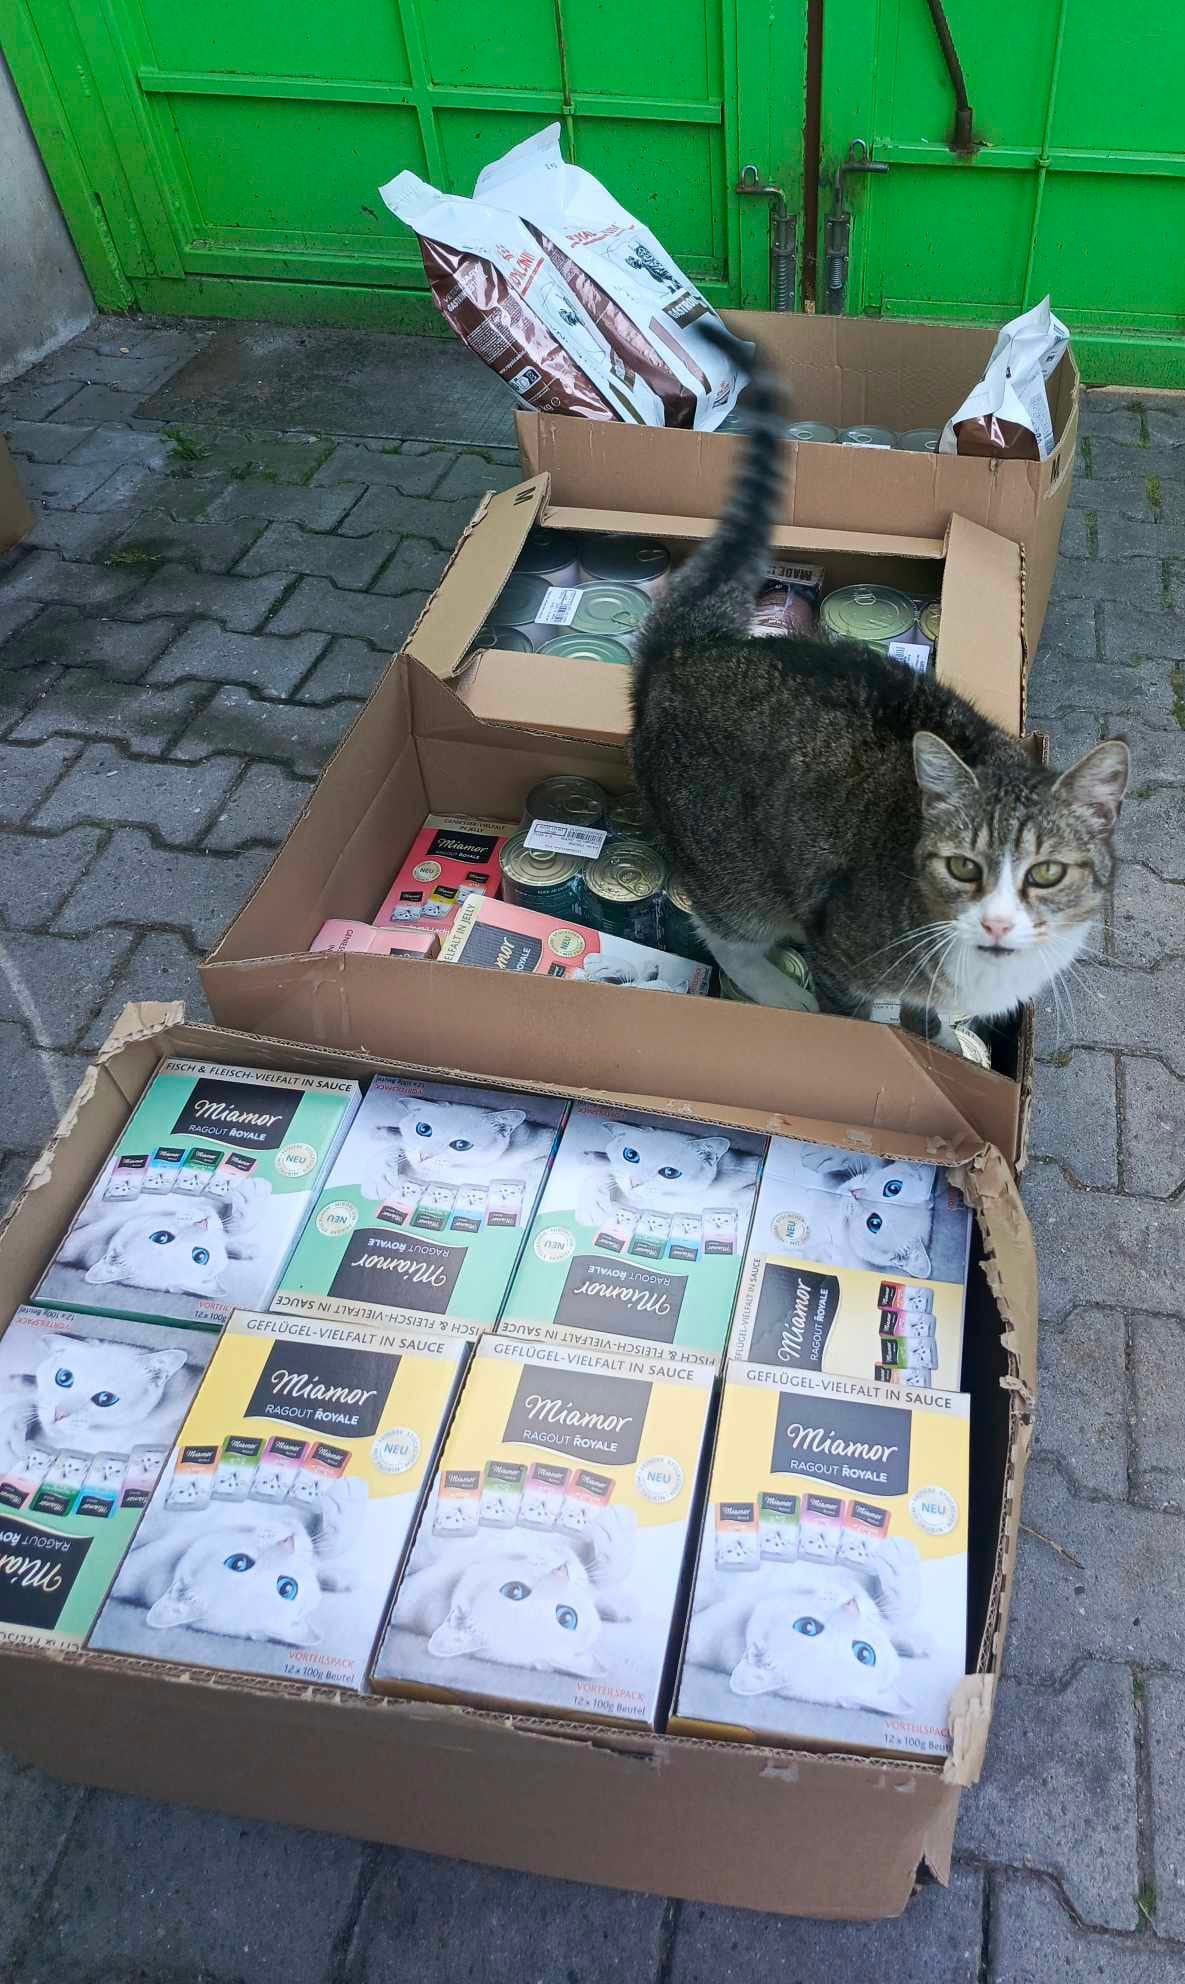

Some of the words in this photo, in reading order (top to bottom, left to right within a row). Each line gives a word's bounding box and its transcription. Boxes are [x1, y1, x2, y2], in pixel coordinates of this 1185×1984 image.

[438, 838, 488, 853] Miamor
[457, 925, 467, 936] IN
[462, 903, 475, 925] JELLY
[165, 1062, 196, 1073] FISCH
[199, 1064, 207, 1073] &
[209, 1066, 300, 1087] FLEISCH-VIELFALT
[301, 1078, 314, 1087] IN
[315, 1080, 353, 1092] SAUCE
[194, 1099, 283, 1128] Miamor
[188, 1124, 228, 1136] RAGOUT
[228, 1127, 267, 1141] ROYALE
[285, 1154, 306, 1164] NEU
[327, 1214, 348, 1225] NEU
[787, 1220, 796, 1239] NEU
[367, 1237, 408, 1253] ROYALE
[408, 1244, 450, 1257] RAGOUT
[544, 1240, 565, 1251] NEU
[351, 1253, 447, 1287] Miamor
[586, 1265, 627, 1281] ROYALE
[751, 1257, 761, 1282] SAUCE
[629, 1272, 671, 1286] RAGOUT
[275, 1295, 315, 1311] SAUCE
[574, 1280, 671, 1315] Miamor
[815, 1288, 829, 1324] ROYALE
[317, 1301, 333, 1313] IN
[334, 1303, 436, 1330] FLEISCH-VIELFALT
[439, 1319, 449, 1332] &
[778, 1278, 812, 1362] Miamor
[246, 1319, 376, 1347] GEFLÜGEL-VIELFALT
[379, 1335, 396, 1347] IN
[398, 1337, 446, 1354] SAUCE
[451, 1322, 484, 1337] ISCH
[501, 1321, 542, 1339] SAUCE
[544, 1329, 558, 1341] IN
[560, 1331, 664, 1359] FLEISCH-VIELFALT
[810, 1325, 825, 1361] RAGOUT
[494, 1343, 625, 1372] GEFLÜGEL-VIELFALT
[629, 1361, 644, 1375] IN
[648, 1363, 695, 1382] SAUCE
[667, 1350, 677, 1361] &
[271, 1369, 376, 1406] Miamor
[746, 1369, 880, 1398] GEFLÜGEL-VIELFALT
[885, 1388, 900, 1400] IN
[905, 1391, 952, 1409] SAUCE
[265, 1404, 314, 1419] RAGOUT
[314, 1408, 359, 1425] ROYALE
[525, 1395, 632, 1433] Miamor
[384, 1443, 409, 1455] NEU
[523, 1430, 571, 1446] RAGOUT
[572, 1434, 619, 1452] ROYALE
[787, 1423, 897, 1463] Miamor
[647, 1471, 671, 1484] NEU
[790, 1459, 839, 1475] RAGOUT
[841, 1464, 888, 1483] ROYALE
[922, 1502, 946, 1515] NEU
[22, 1536, 72, 1552] RAGOUT
[284, 1664, 294, 1673] 12
[303, 1667, 323, 1679] 100g
[325, 1671, 355, 1681] Beutel
[574, 1696, 584, 1705] 12
[593, 1698, 614, 1712] 100g
[617, 1703, 645, 1715] Beutel
[884, 1733, 895, 1744] 12
[905, 1736, 926, 1751] 100g
